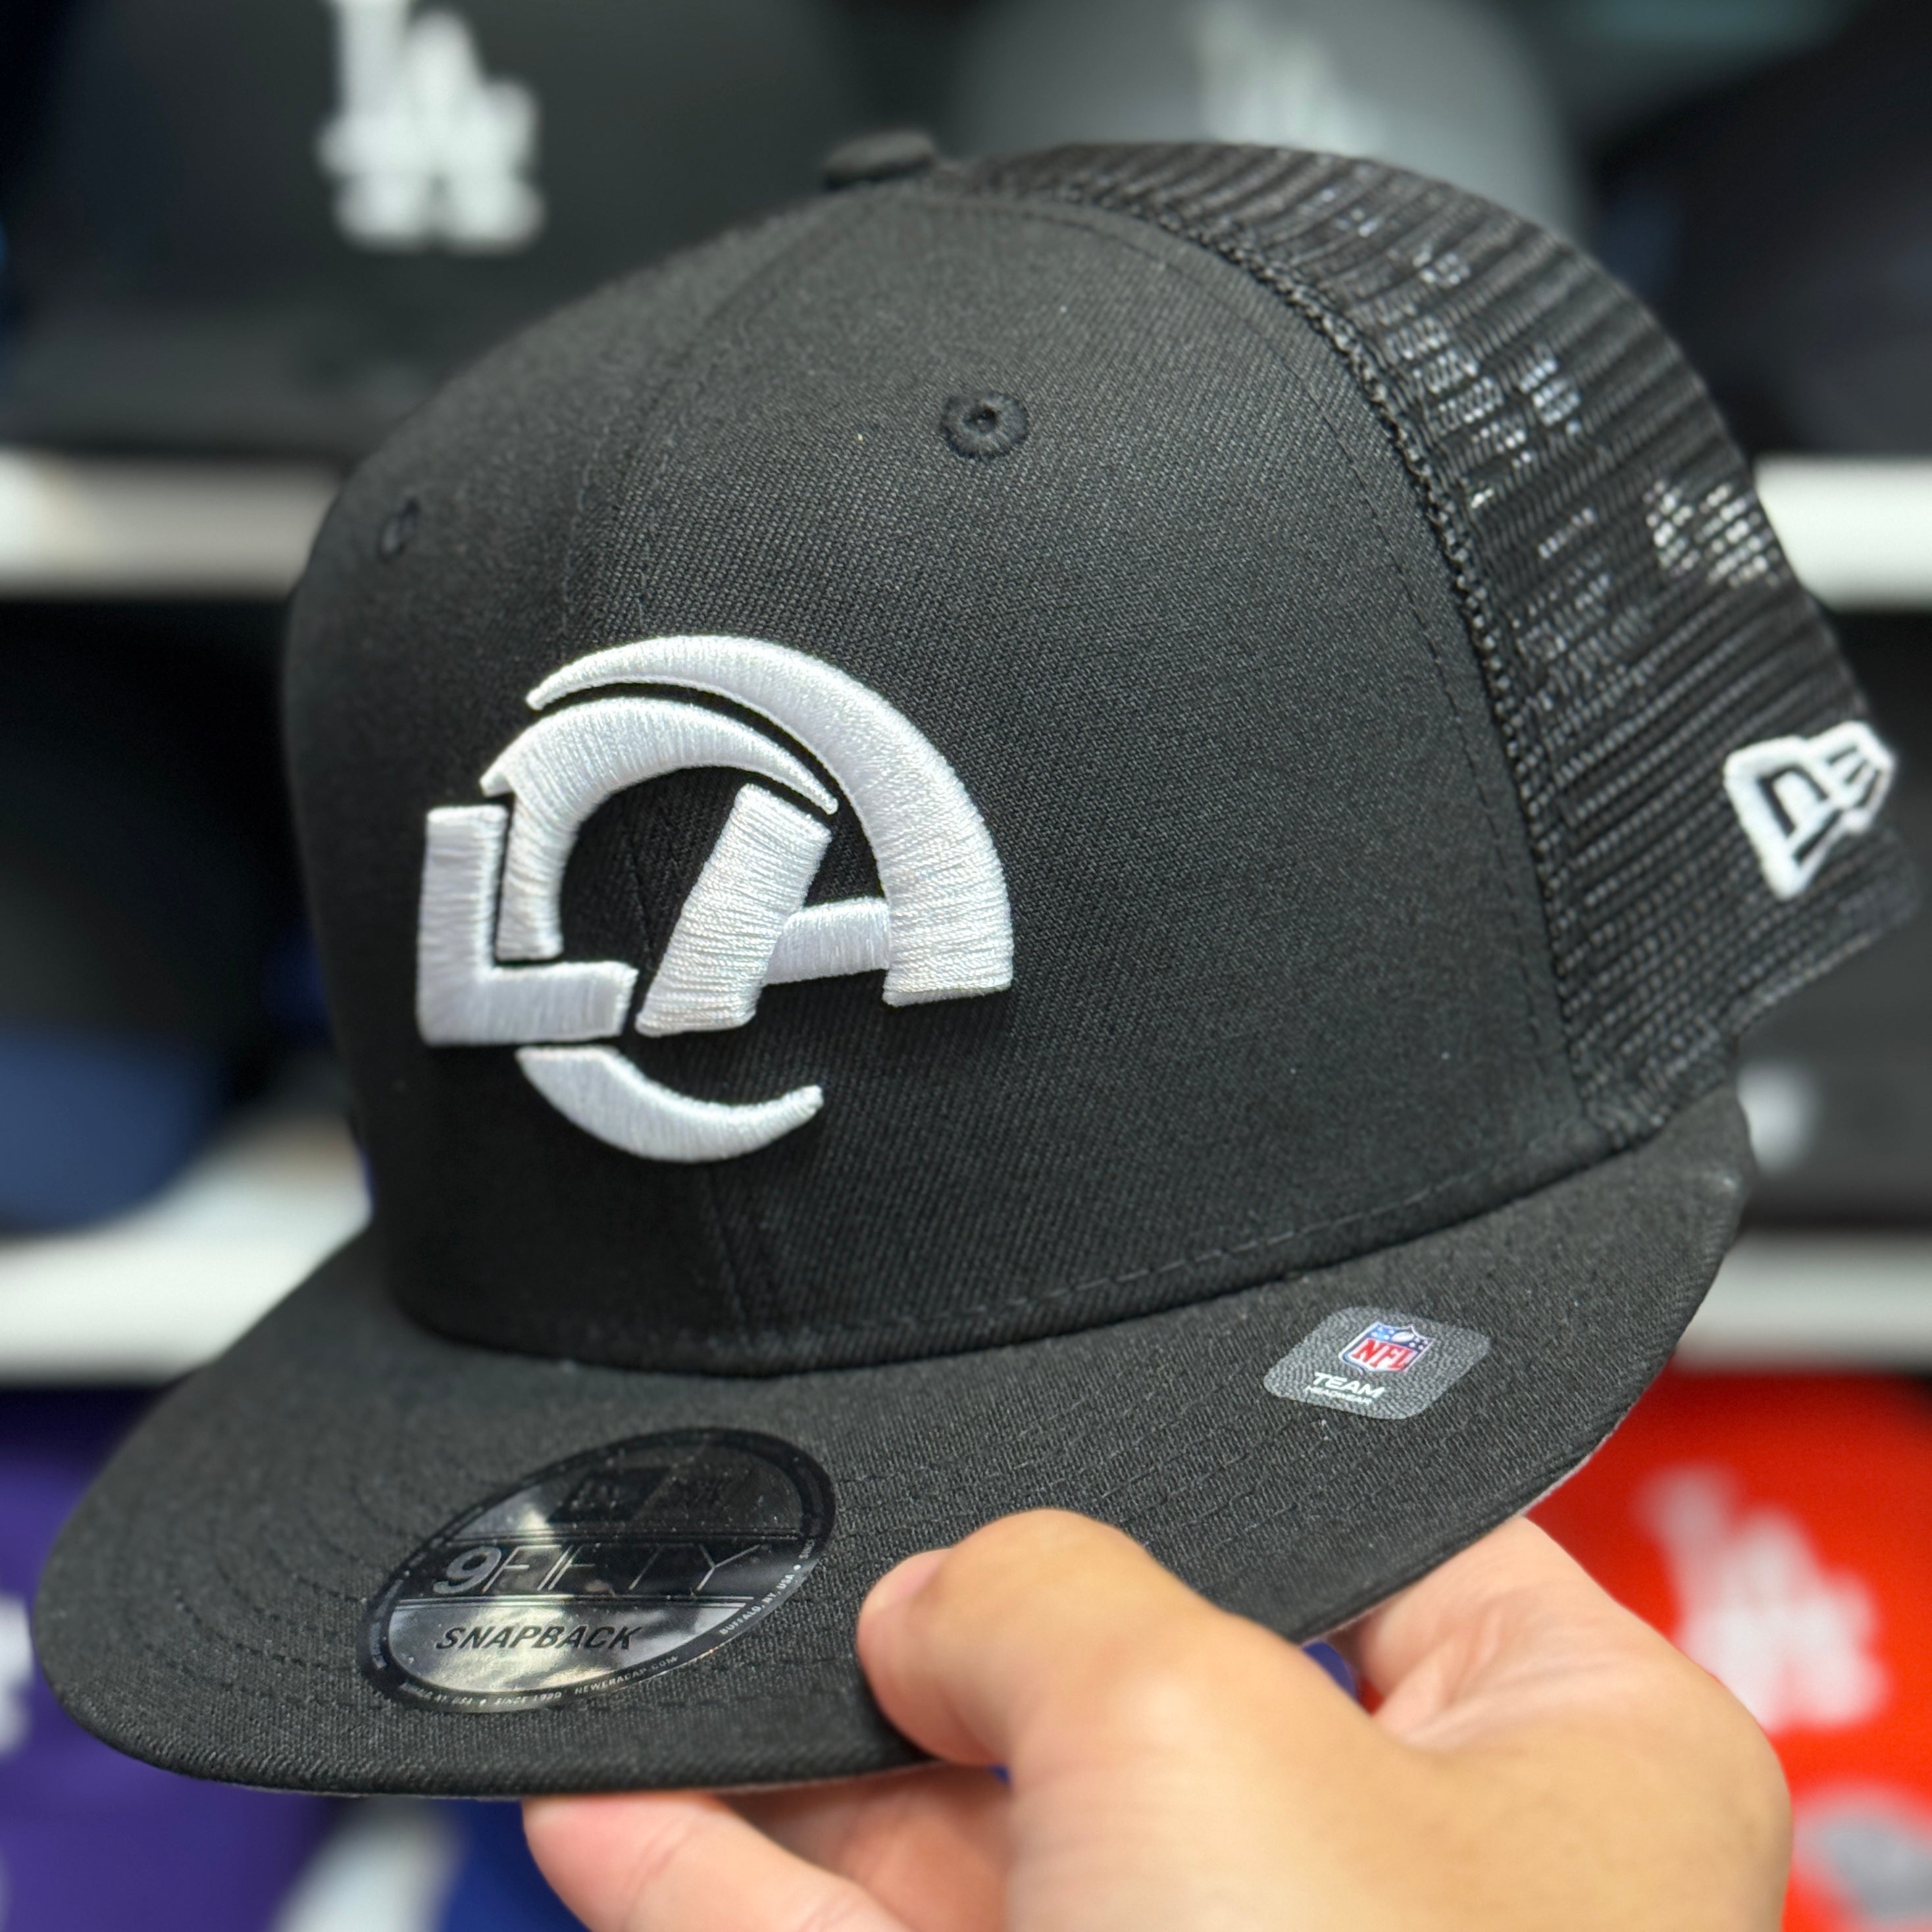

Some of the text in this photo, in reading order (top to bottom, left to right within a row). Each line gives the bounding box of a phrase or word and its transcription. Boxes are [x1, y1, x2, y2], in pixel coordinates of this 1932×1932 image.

[1350, 1338, 1416, 1369] NFL
[1313, 1372, 1385, 1399] TEAM
[432, 1544, 761, 1594] 9FIFTY
[436, 1626, 643, 1650] SNAPBACK
